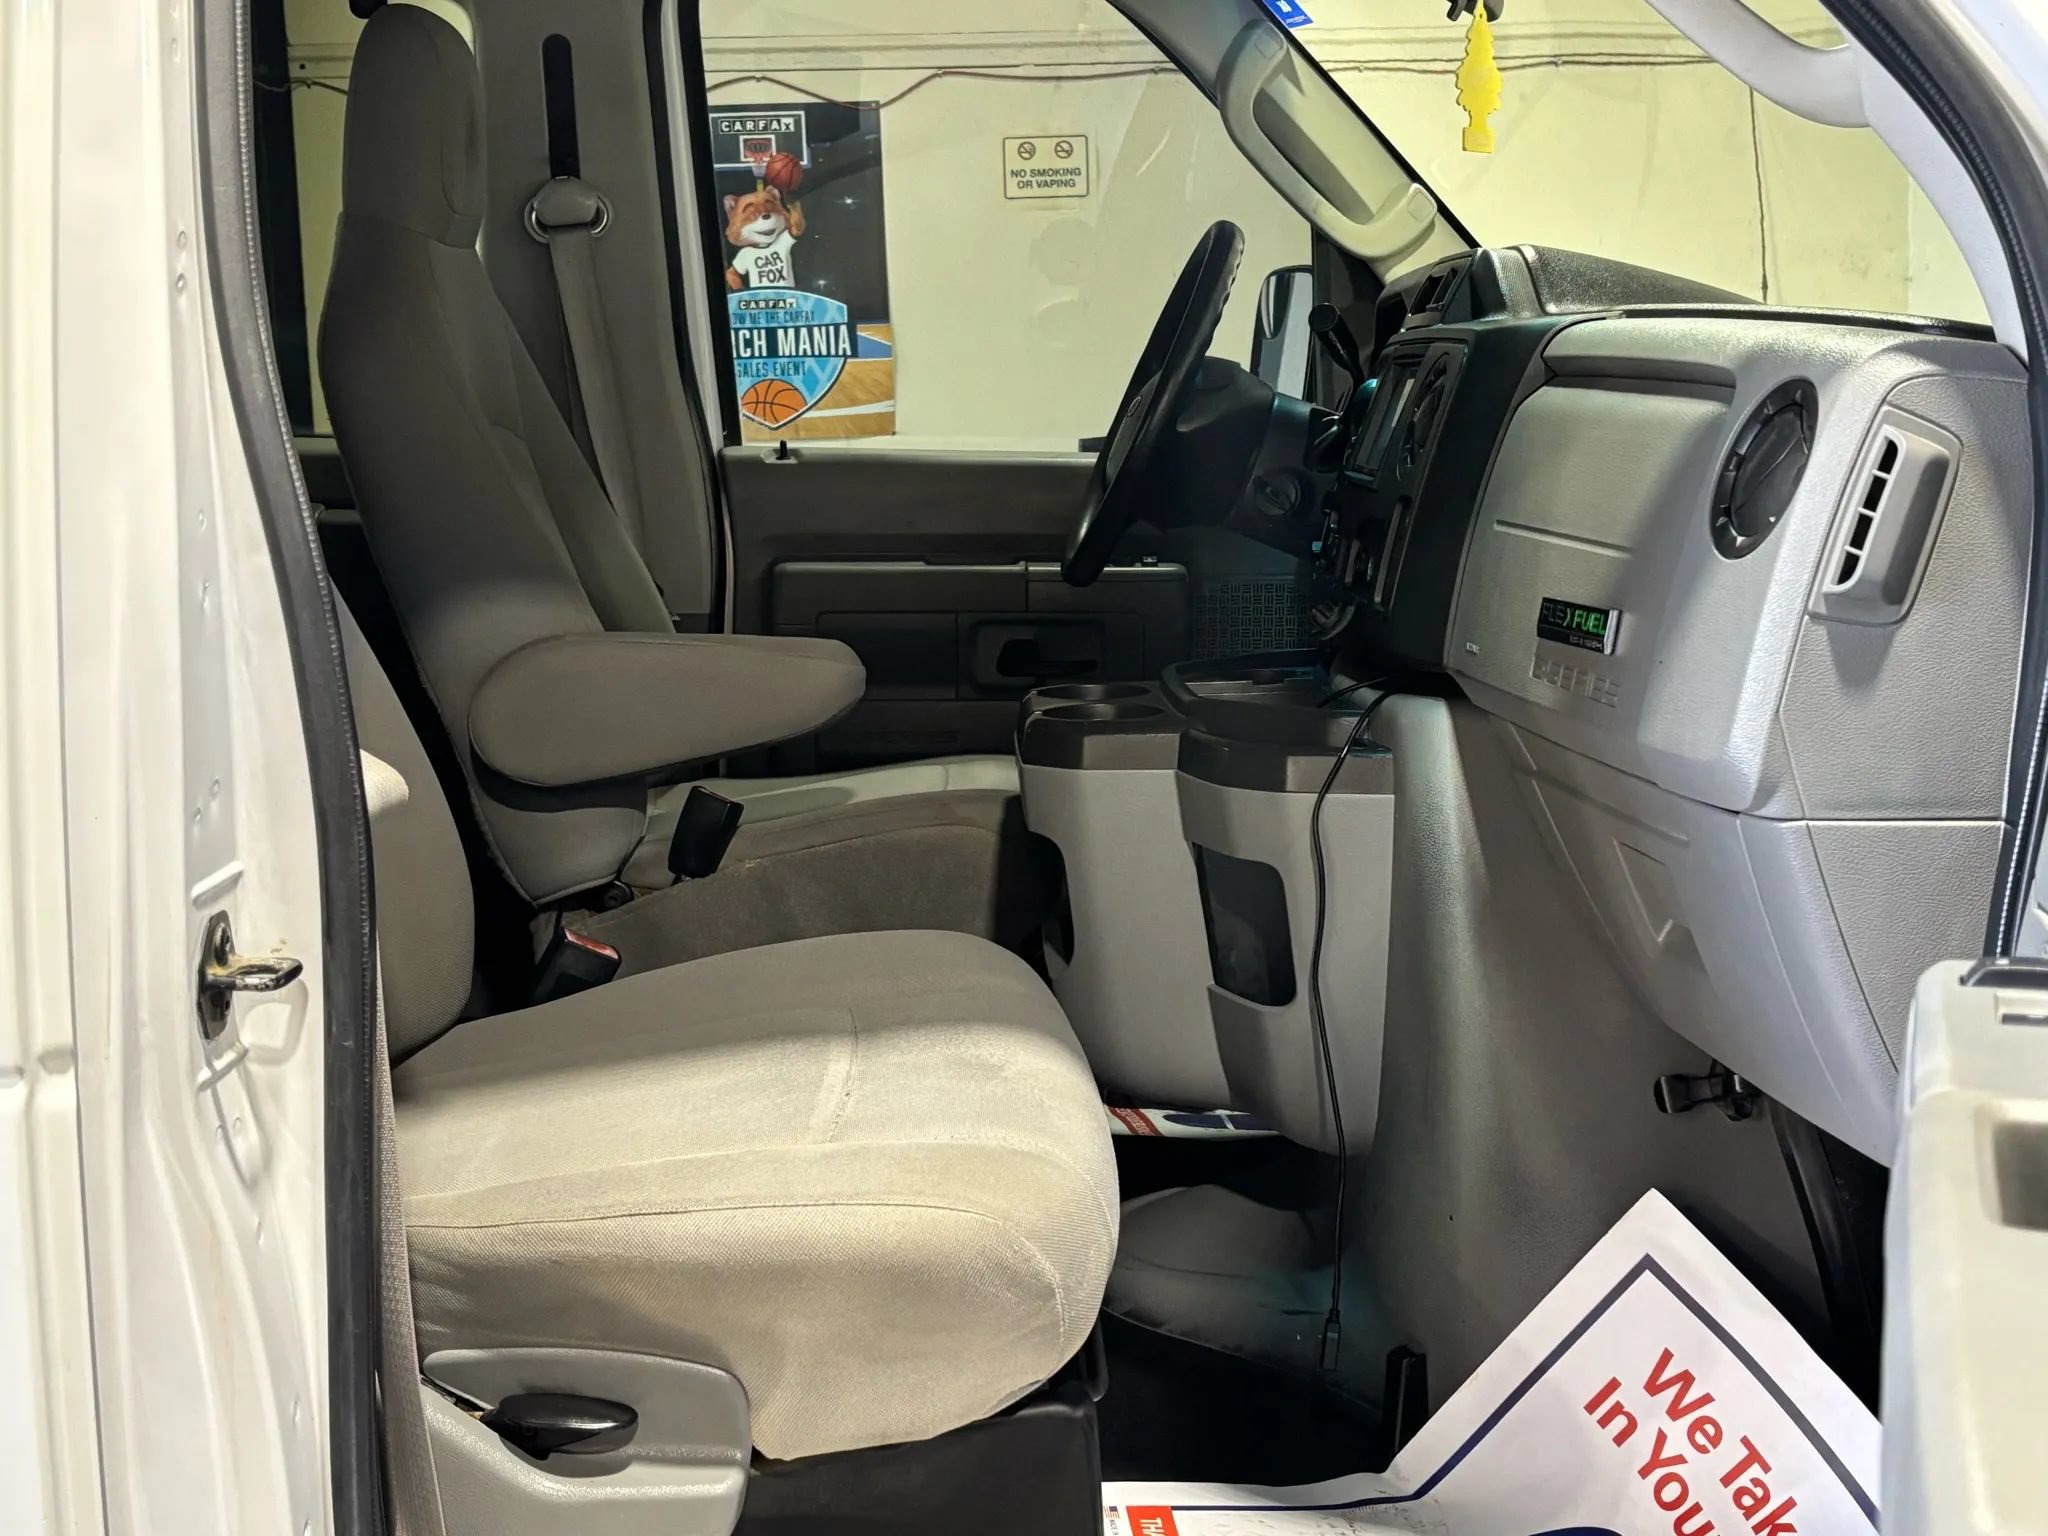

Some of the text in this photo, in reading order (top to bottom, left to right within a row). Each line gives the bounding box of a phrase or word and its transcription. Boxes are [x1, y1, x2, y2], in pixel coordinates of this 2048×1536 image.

[720, 117, 795, 134] CARFAX
[1011, 167, 1082, 178] NO SMOKING
[1017, 178, 1076, 189] OR VAPING
[754, 251, 784, 270] CAR
[758, 265, 786, 284] FOX
[739, 298, 797, 310] CARFAX
[749, 312, 762, 325] ME
[765, 311, 781, 324] THE
[777, 324, 852, 357] MANIA
[737, 361, 806, 378] SALES EVENT
[1643, 1347, 1723, 1454] We
[1583, 1376, 1638, 1448] In
